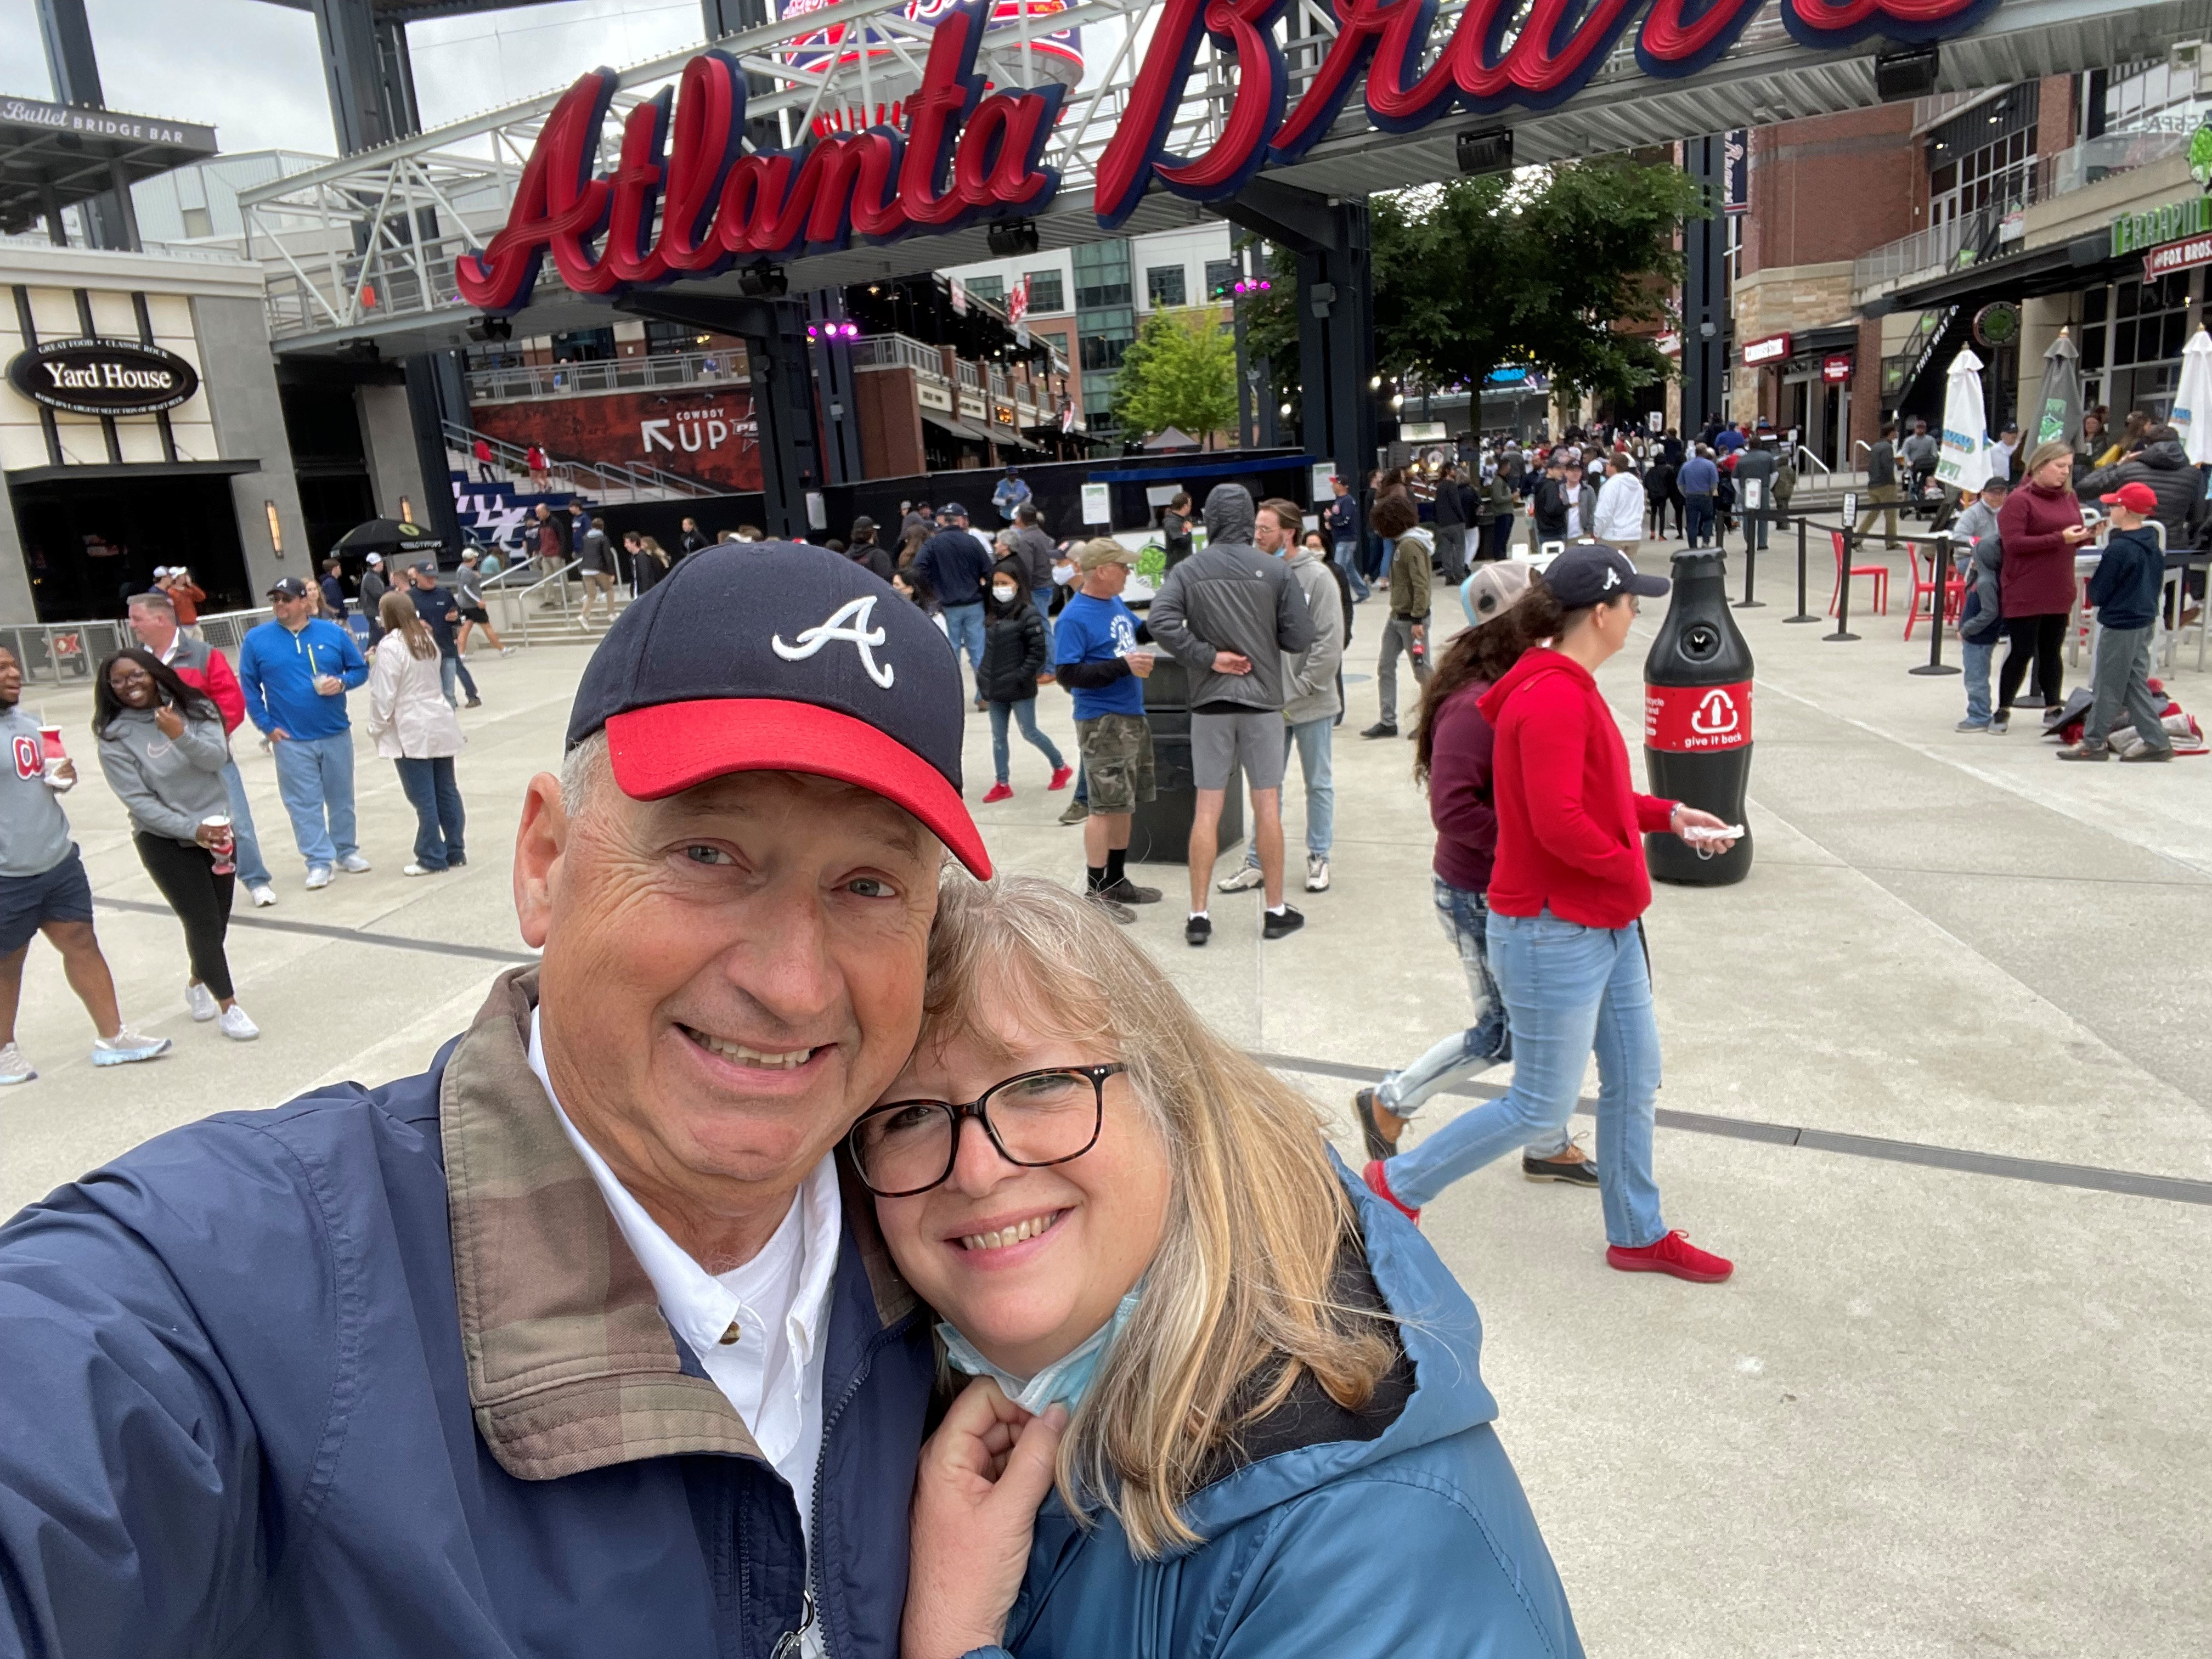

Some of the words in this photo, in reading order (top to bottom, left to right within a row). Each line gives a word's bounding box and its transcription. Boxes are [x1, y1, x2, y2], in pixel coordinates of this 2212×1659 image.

[2, 100, 69, 127] Bullet
[72, 116, 142, 138] BRIDGE
[149, 127, 183, 144] BAR
[1095, 0, 2002, 229] Bra
[455, 0, 1066, 317] Atlanta
[2163, 247, 2182, 267] FOX
[1932, 316, 1948, 346] WAY
[38, 341, 67, 354] GREAT
[68, 338, 94, 349] FOOD
[105, 339, 139, 351] CLASSIC
[143, 343, 168, 359] ROCK
[43, 362, 101, 389] Yard
[101, 363, 172, 390] House
[675, 408, 725, 422] COWBOY
[678, 419, 728, 453] UP
[771, 595, 894, 690] A
[1684, 735, 1708, 748] give
[1711, 735, 1719, 746] it
[1721, 731, 1742, 744] back
